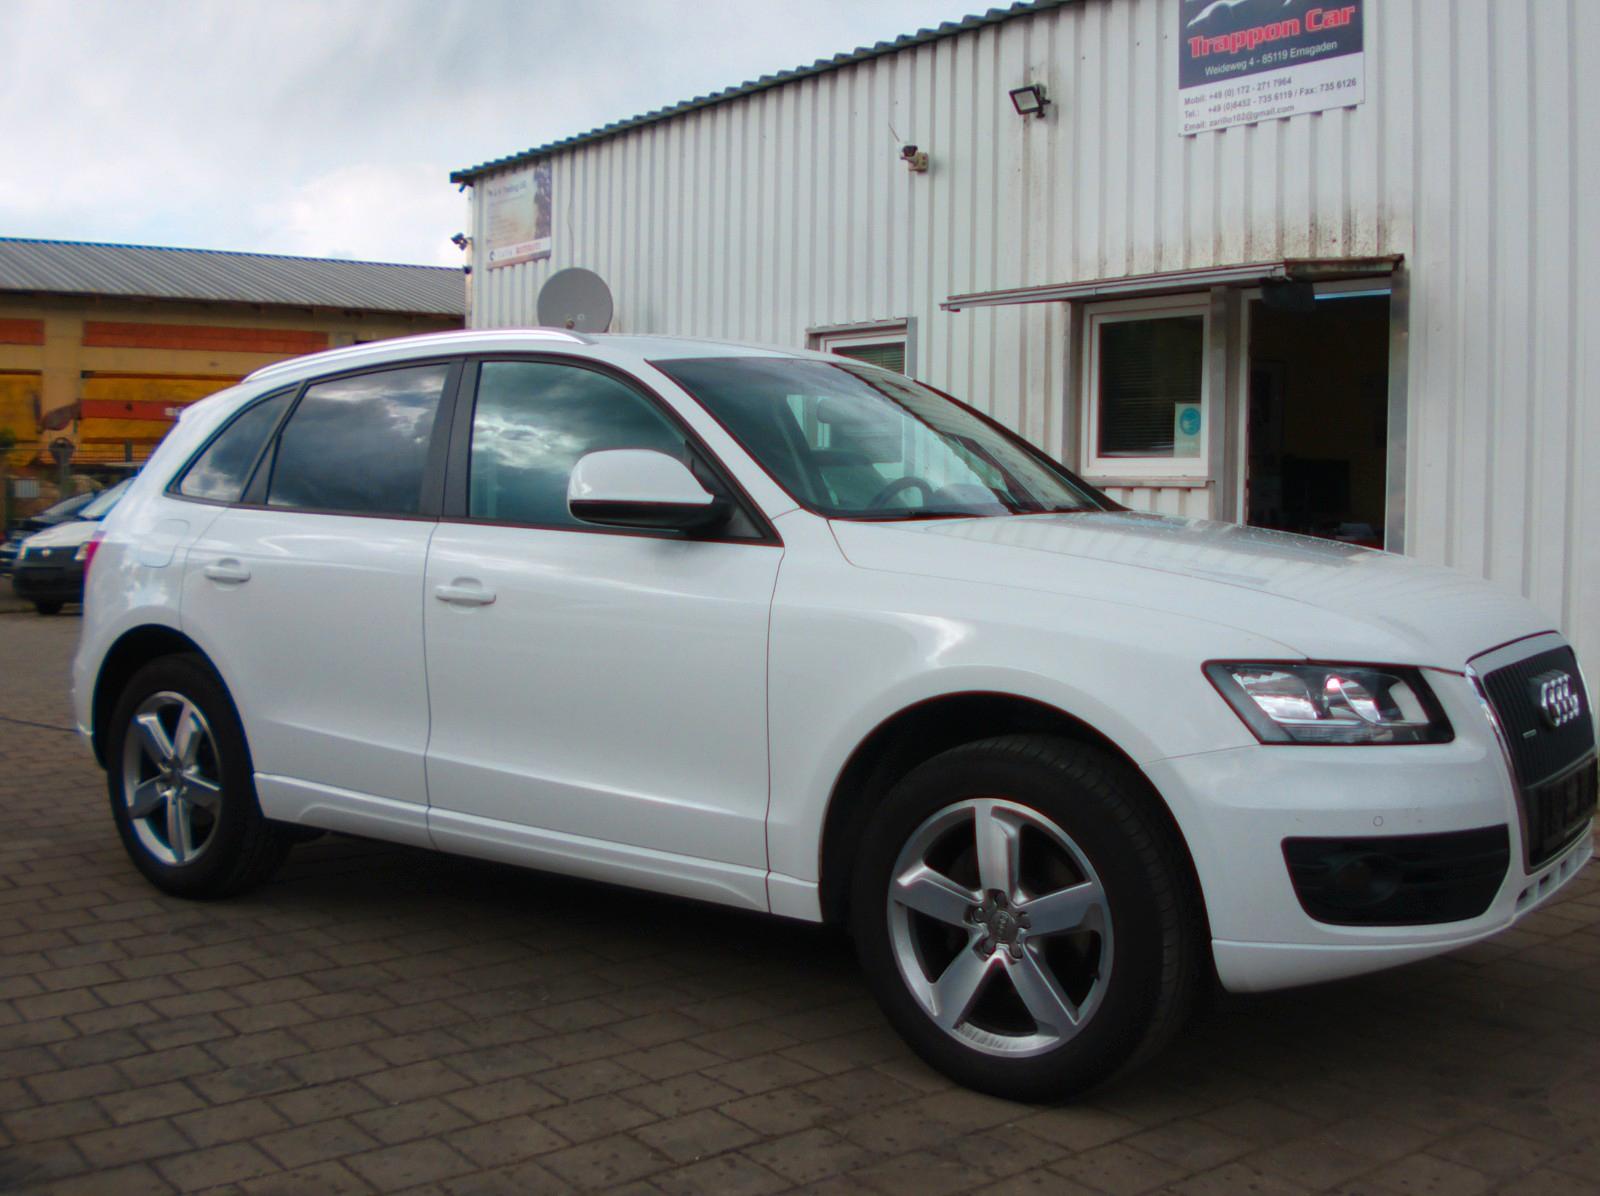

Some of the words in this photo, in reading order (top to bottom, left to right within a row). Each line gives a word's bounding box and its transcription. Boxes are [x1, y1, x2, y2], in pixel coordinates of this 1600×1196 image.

[1188, 17, 1300, 59] Trappon
[1305, 5, 1356, 32] Car
[1262, 49, 1289, 64] 85119
[1257, 80, 1271, 92] 271
[1320, 80, 1335, 92] 735
